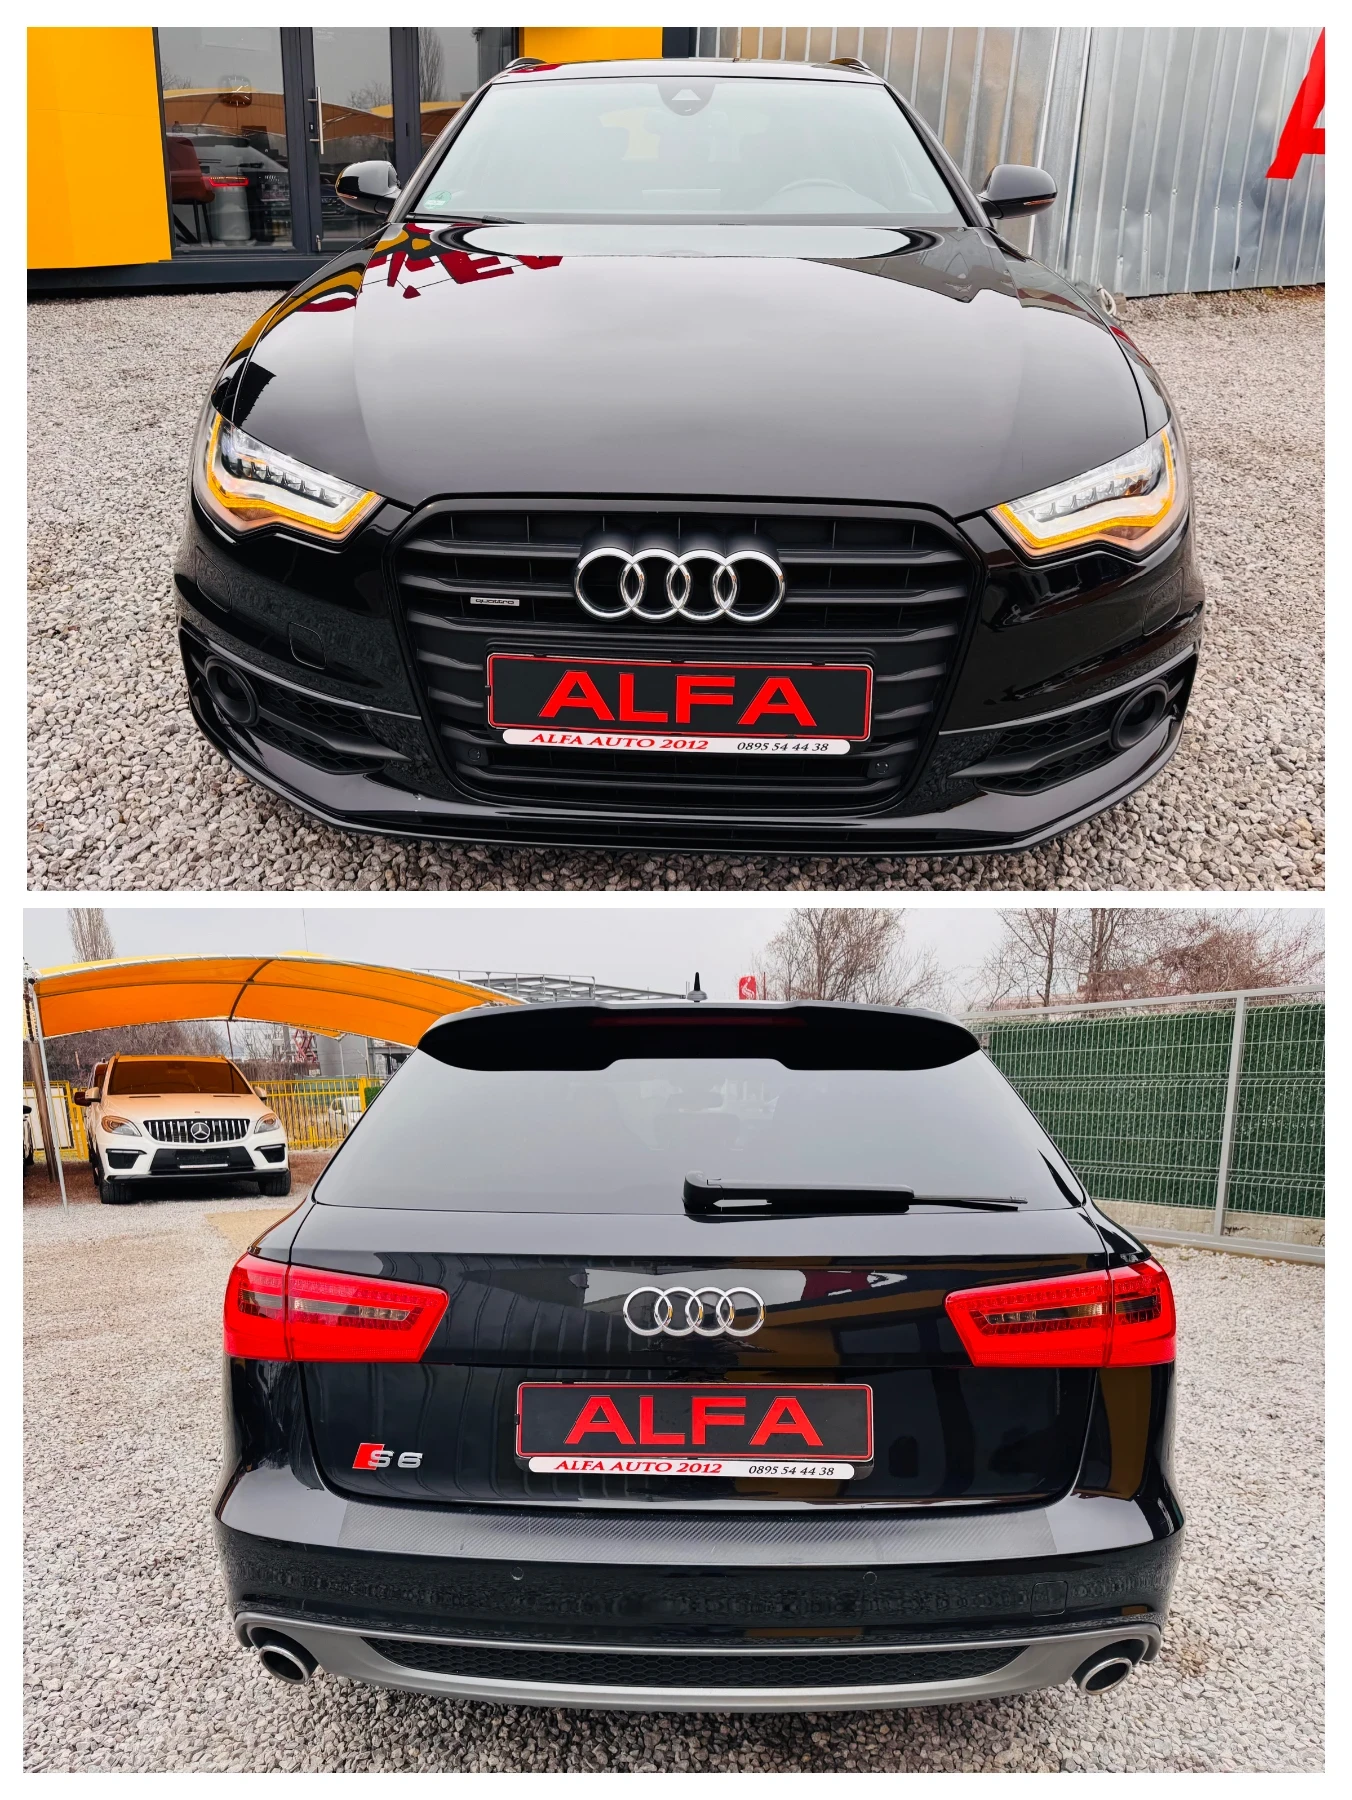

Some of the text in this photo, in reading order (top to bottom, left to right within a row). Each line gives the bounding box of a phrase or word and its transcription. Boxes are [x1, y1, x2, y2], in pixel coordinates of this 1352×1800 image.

[538, 669, 817, 727] ALFA
[529, 733, 829, 752] ALFA AUTO 2012 0895 54 44 38
[564, 1395, 824, 1447] ALFA
[367, 1450, 424, 1469] S6
[554, 1460, 835, 1476] ALFA AUTO 2012 0895 54 44 38
